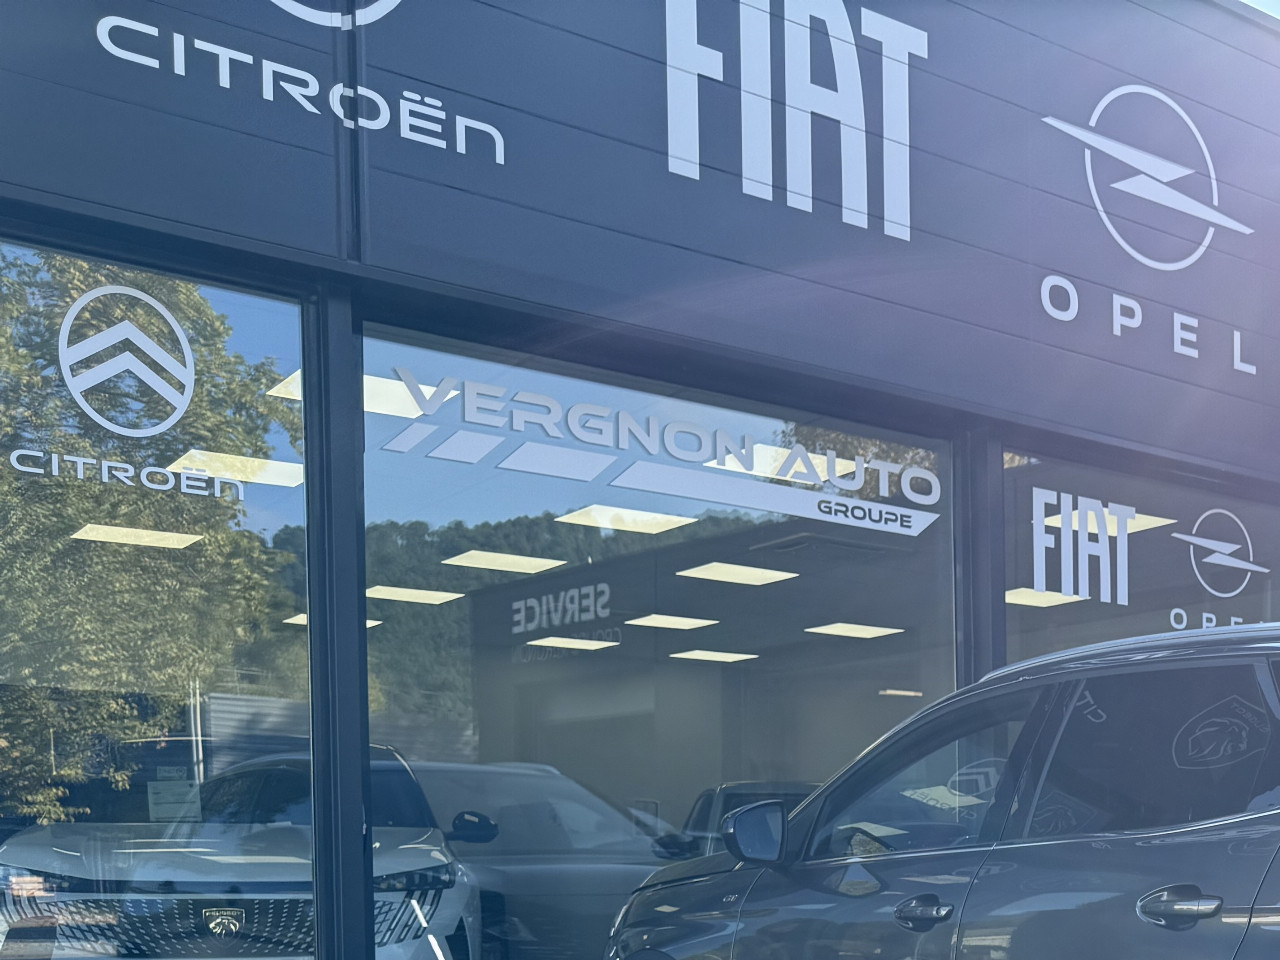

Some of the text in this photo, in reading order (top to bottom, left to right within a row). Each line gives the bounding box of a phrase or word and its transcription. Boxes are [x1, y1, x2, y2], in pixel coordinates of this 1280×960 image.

[665, 0, 928, 241] FIAT
[1040, 275, 1257, 375] OPEL
[394, 367, 942, 505] VERGNON AUTO
[817, 500, 913, 530] GROUPE
[1032, 487, 1136, 606] FIAT
